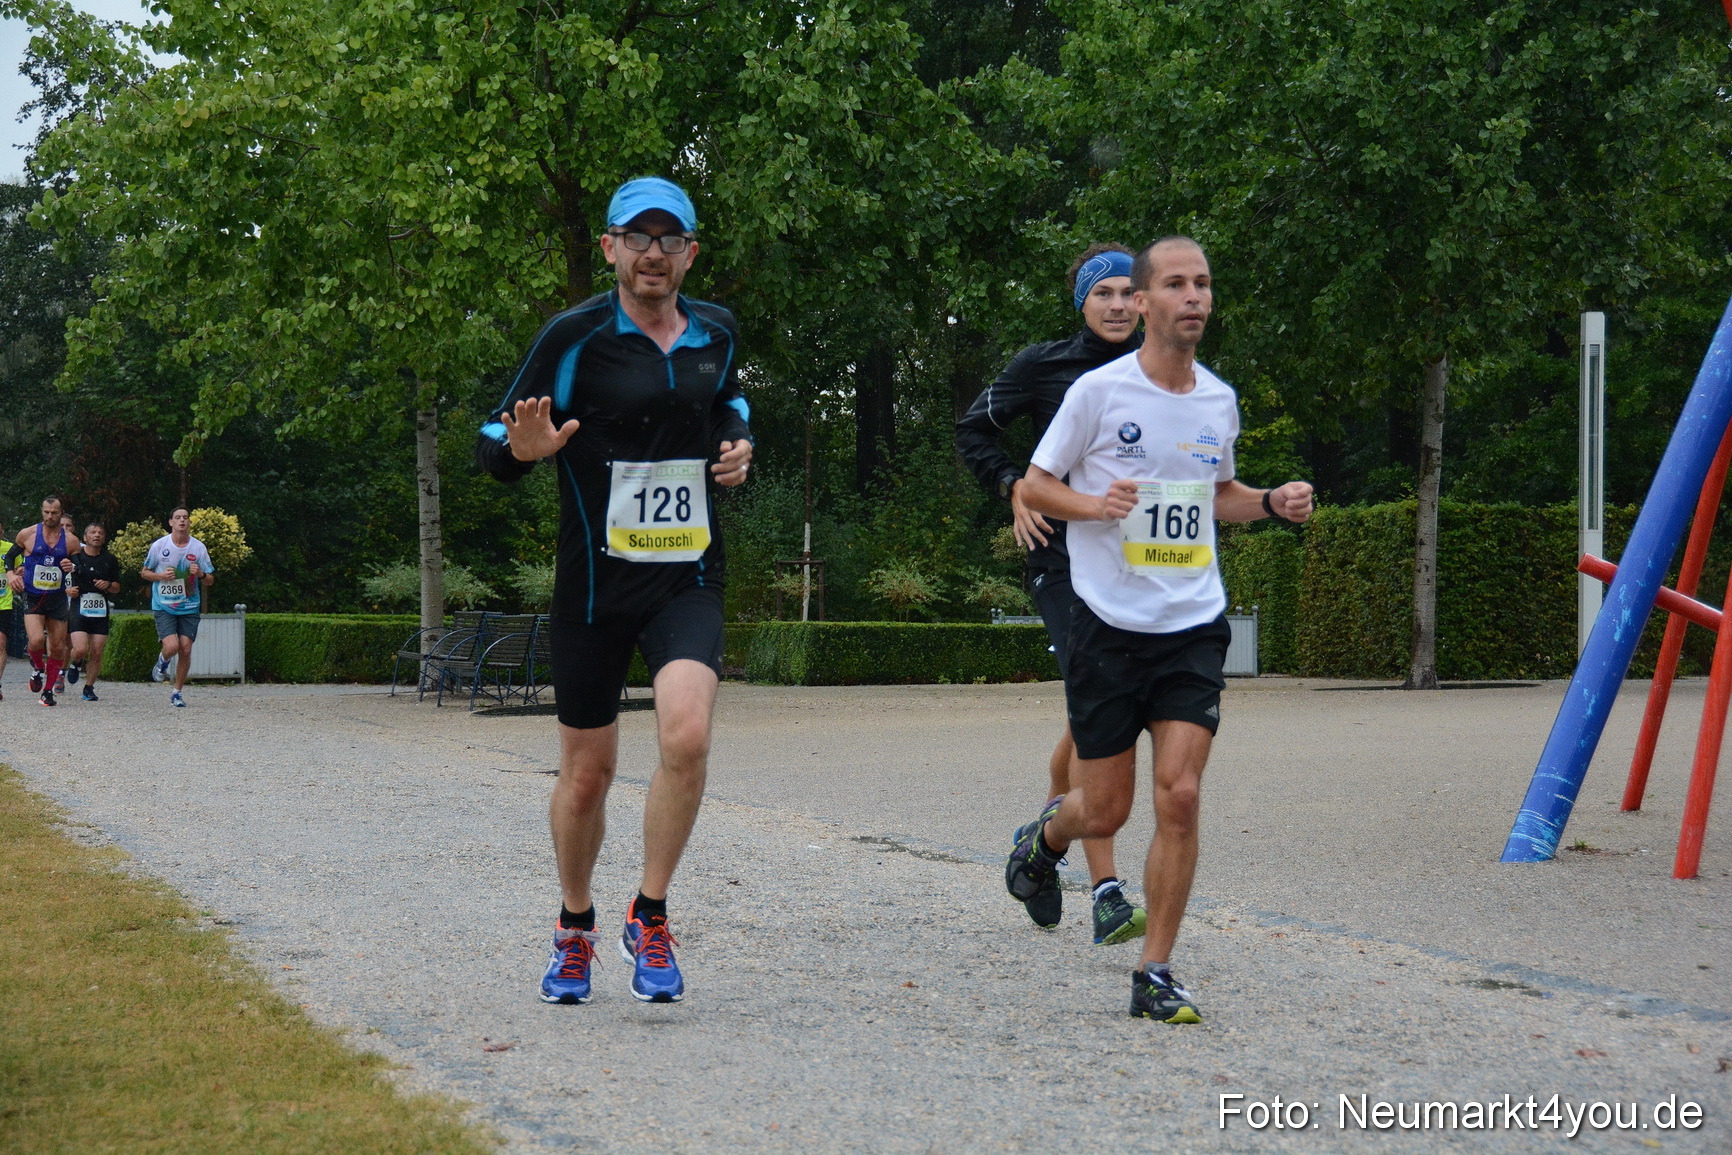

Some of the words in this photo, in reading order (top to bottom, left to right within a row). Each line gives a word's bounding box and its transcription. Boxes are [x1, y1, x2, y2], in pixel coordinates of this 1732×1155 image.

[1116, 445, 1146, 453] PARTL
[656, 465, 699, 477] BOCK
[1166, 484, 1208, 496] BOCK
[633, 486, 691, 523] 128
[1145, 503, 1200, 540] 168
[629, 533, 692, 548] Schorschi
[1145, 548, 1192, 563] Michael
[40, 571, 57, 582] 203
[161, 585, 183, 595] 2369
[83, 599, 104, 609] 2388
